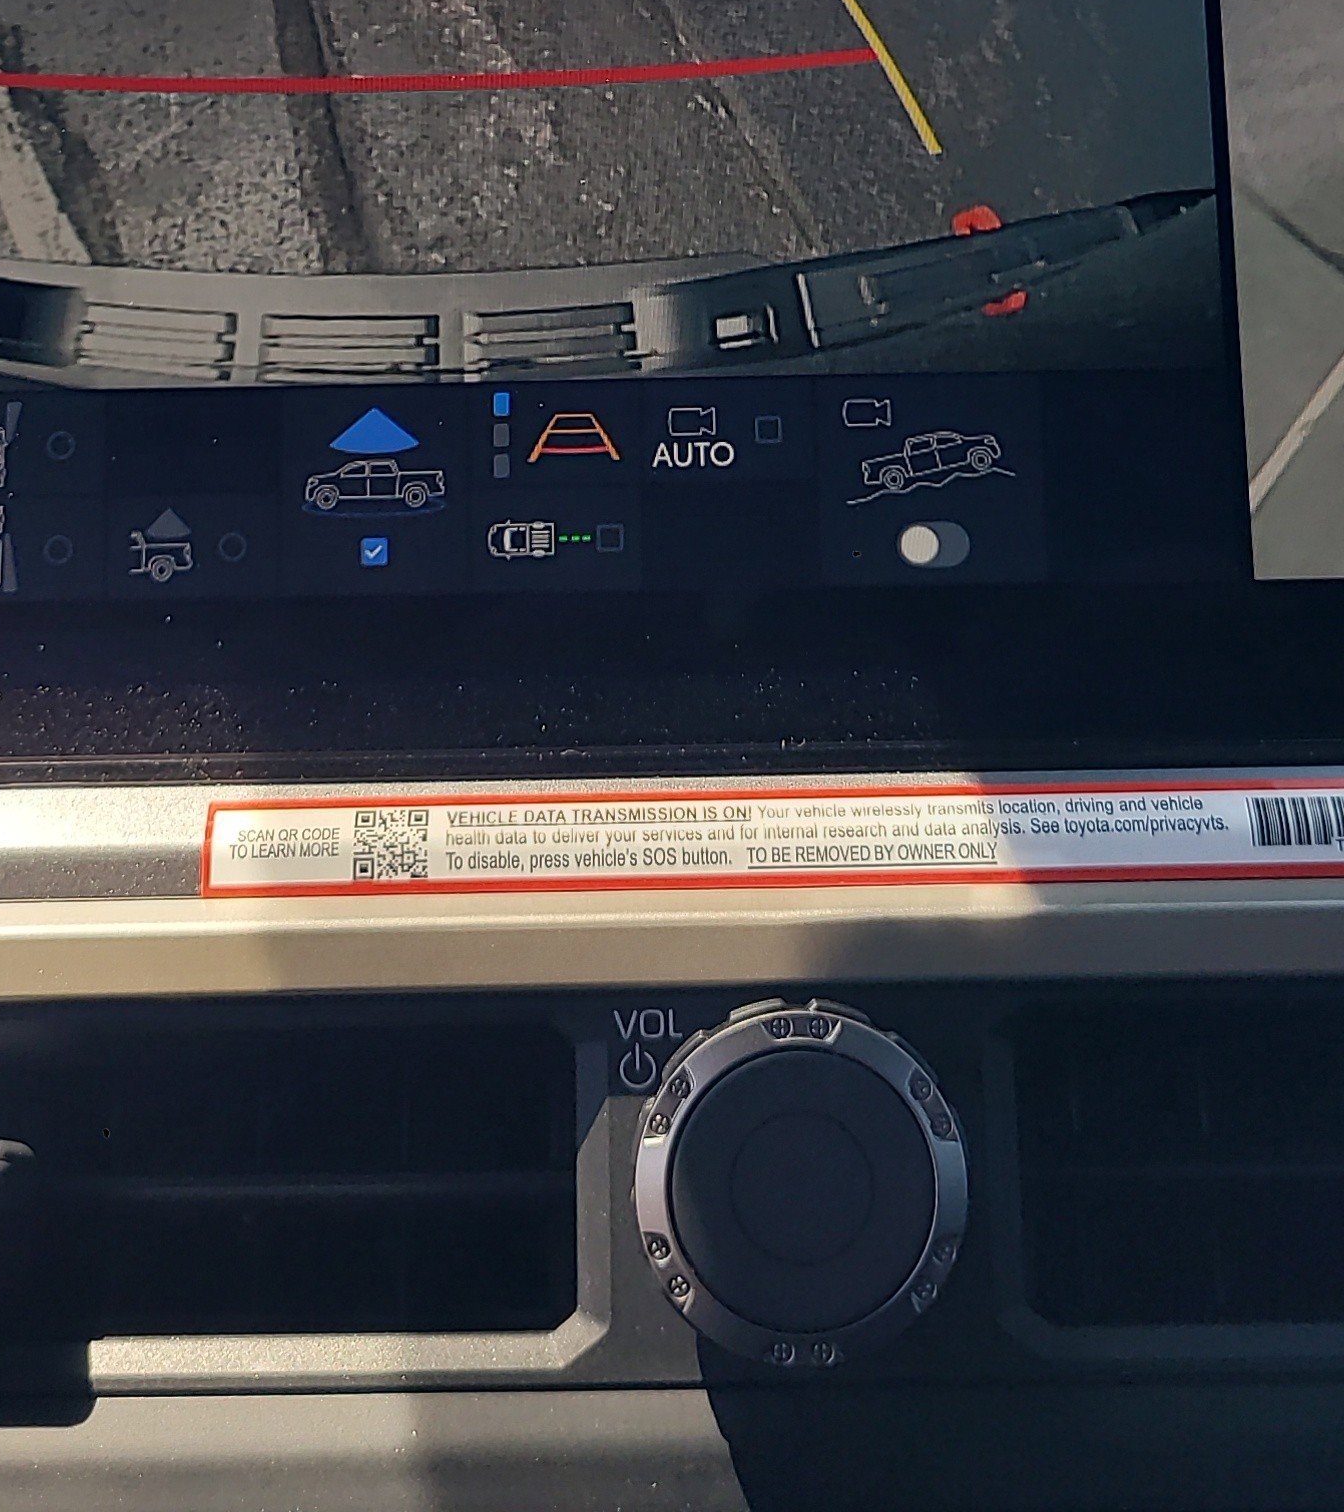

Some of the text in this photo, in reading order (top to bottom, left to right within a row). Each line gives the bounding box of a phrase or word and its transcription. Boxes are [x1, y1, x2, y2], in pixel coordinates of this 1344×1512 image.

[653, 441, 735, 469] AUTO
[447, 795, 1204, 825] VEHICLE DATA TRANSMISSION IS ON! Your vehicle wirelessly transmits location, driving and vehicle
[237, 827, 341, 843] SCAN QR CODE
[445, 815, 1230, 847] health data to deliver your services and for internal research and data analysis. See toyota.com/privacyvts.
[229, 841, 340, 859] TO LEARN MORE
[445, 841, 998, 873] To disable, press vehicle's SOS button. TO BE REMOVED BY OWNER ONLY
[613, 1008, 683, 1040] VOL
